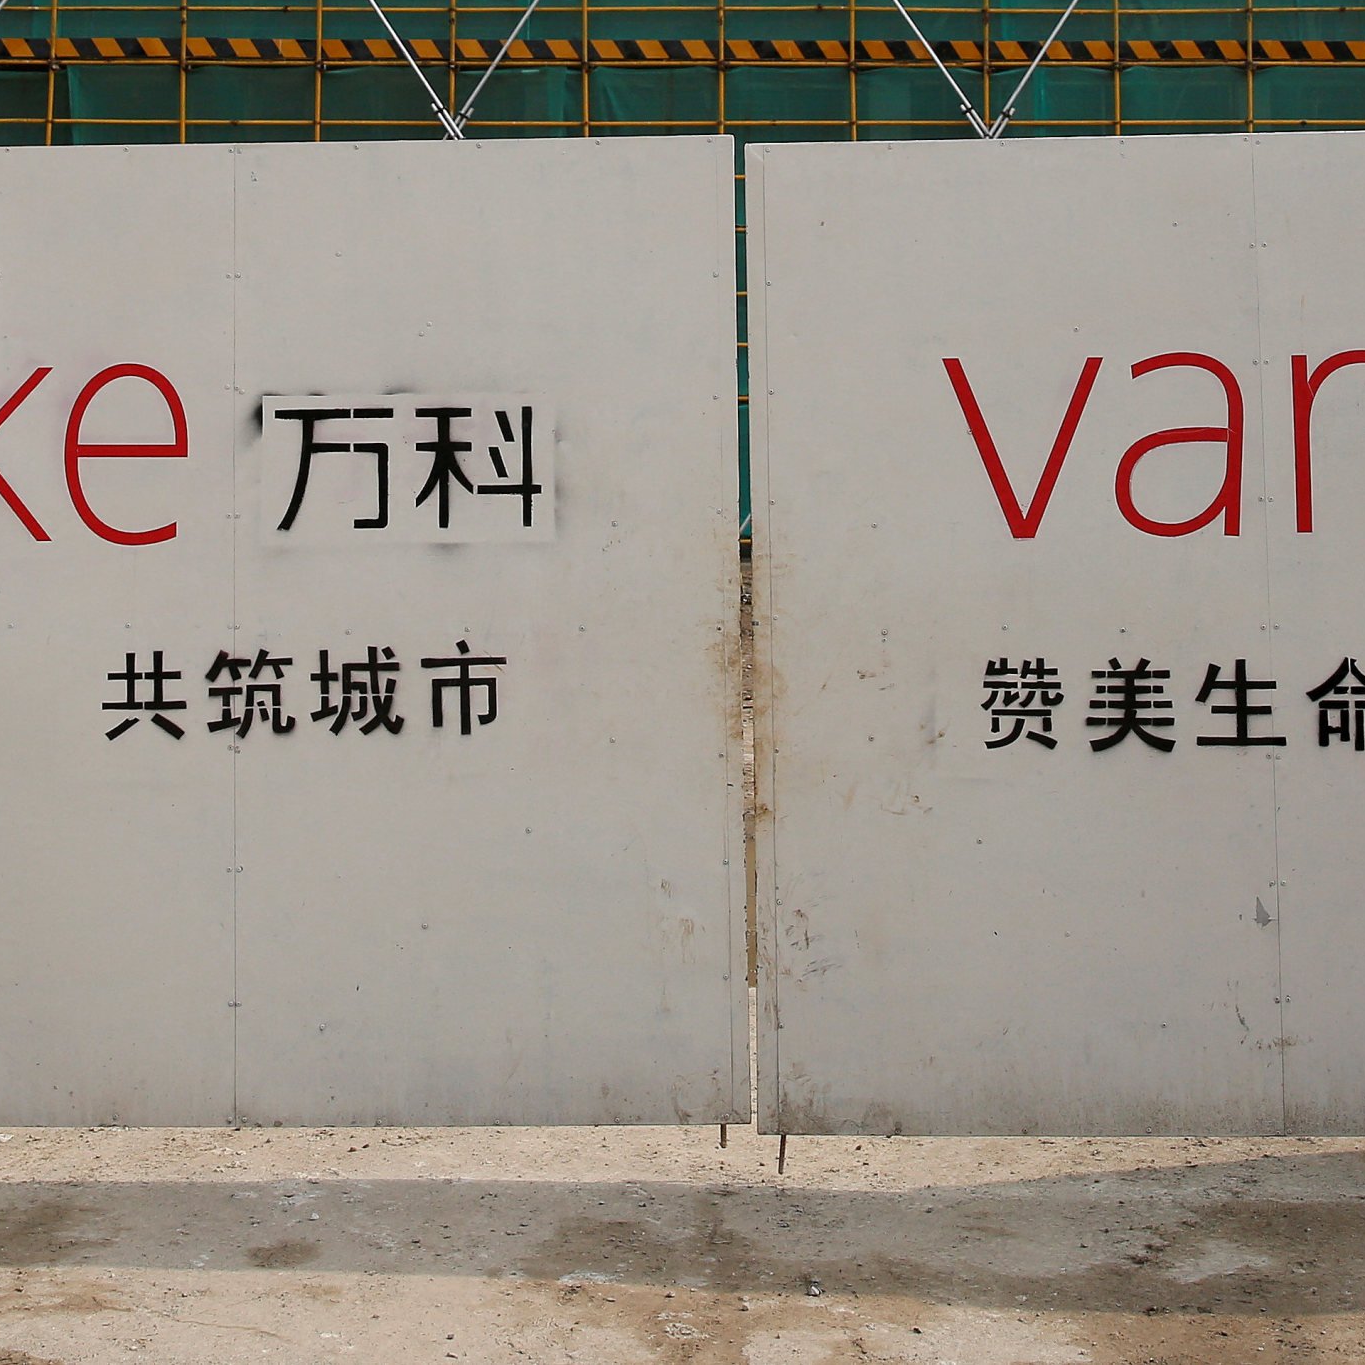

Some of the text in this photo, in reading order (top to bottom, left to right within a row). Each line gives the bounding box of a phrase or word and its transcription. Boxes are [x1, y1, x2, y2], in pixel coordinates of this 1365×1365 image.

[274, 406, 542, 531] 万科
[101, 639, 507, 741] 共筑城市
